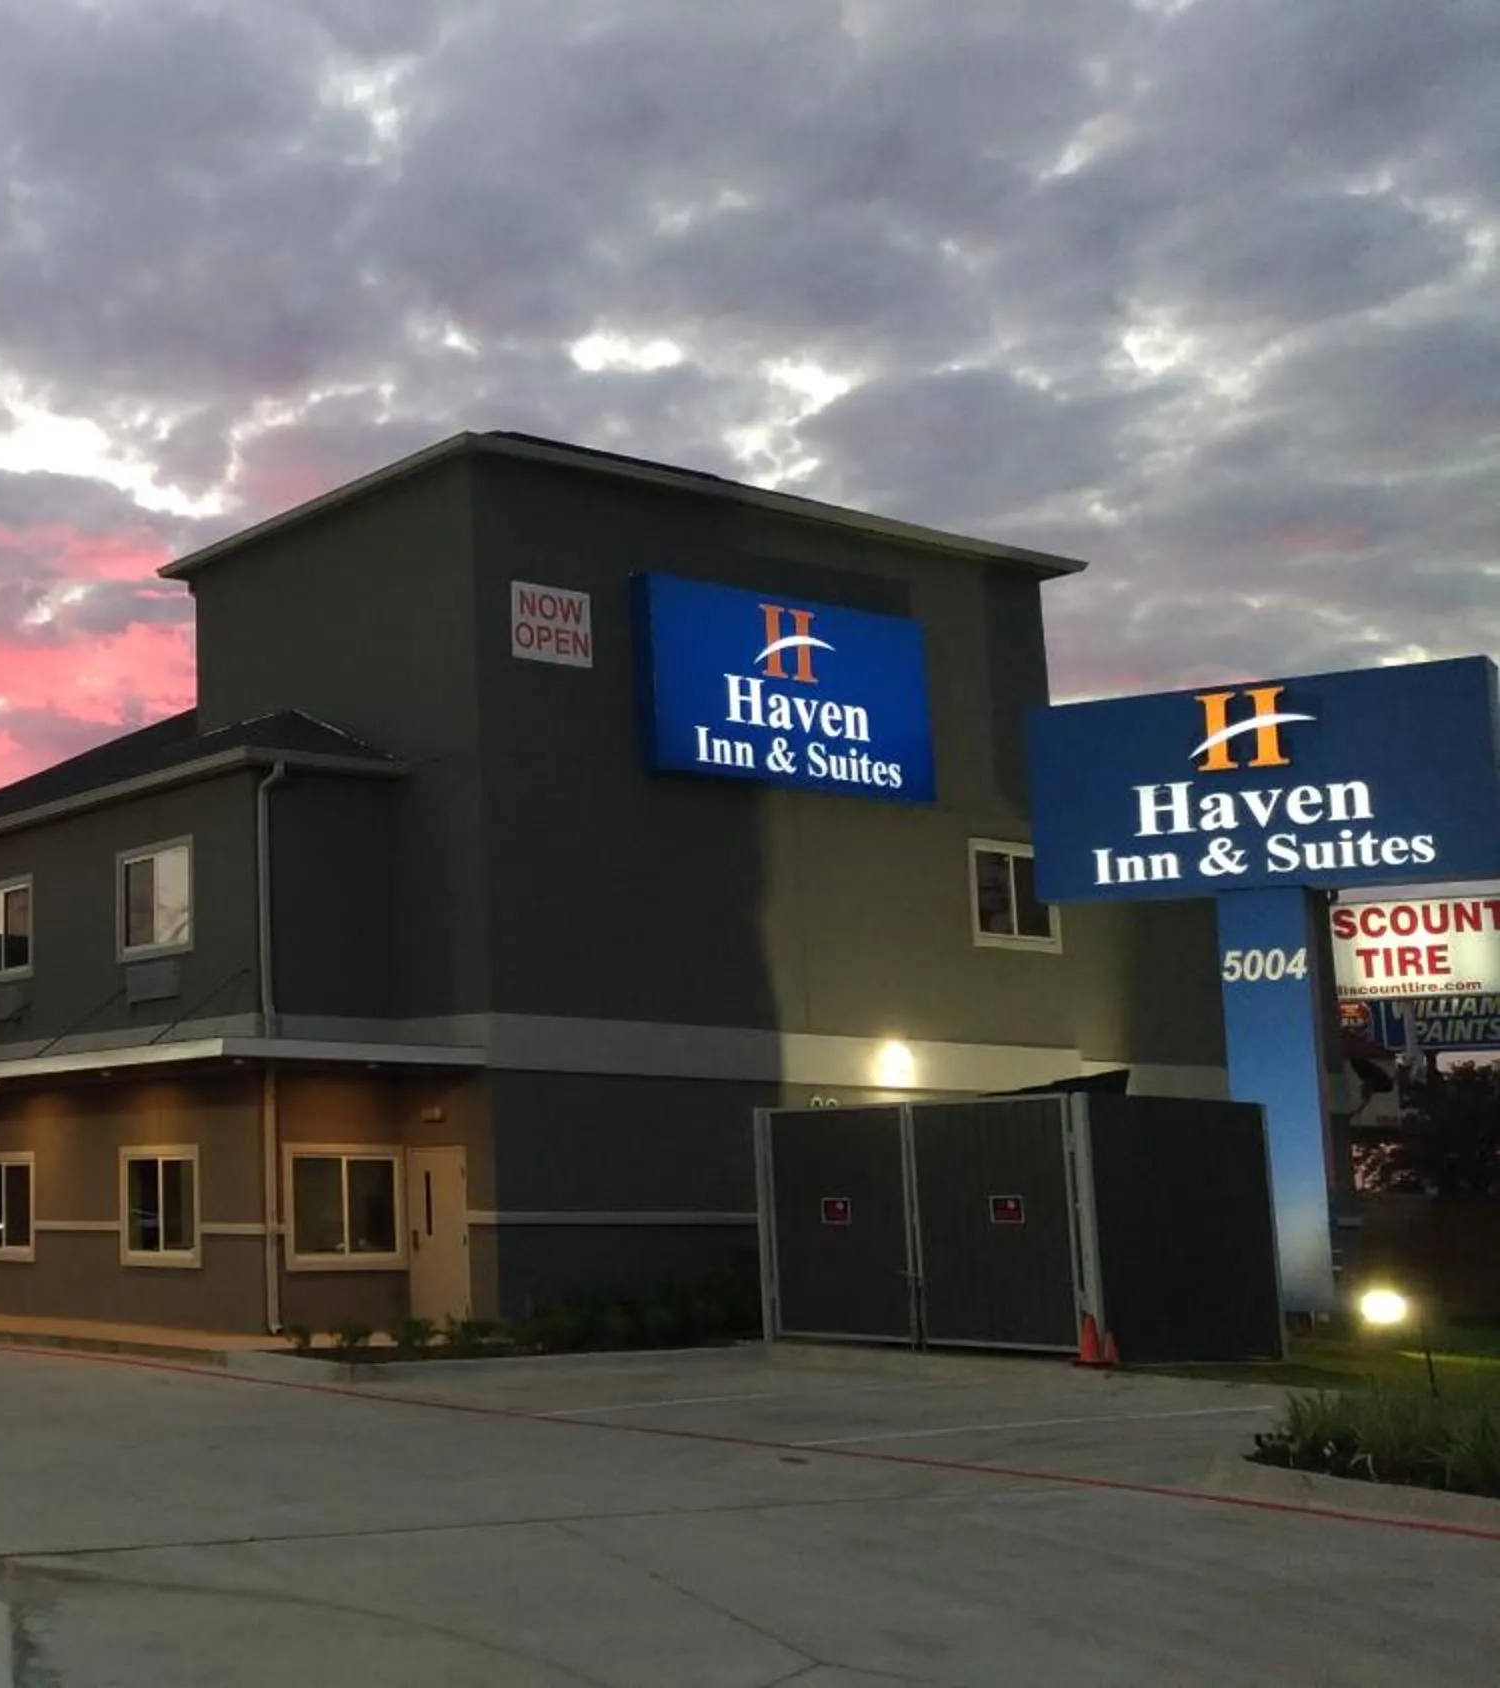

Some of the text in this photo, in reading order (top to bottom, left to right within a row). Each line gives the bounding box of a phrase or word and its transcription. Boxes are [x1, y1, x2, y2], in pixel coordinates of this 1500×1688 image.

[519, 590, 583, 625] NOW
[515, 622, 589, 659] OPEN
[724, 673, 871, 743] Haven
[694, 725, 903, 789] Inn & Suites
[1131, 780, 1374, 837] Haven
[1092, 829, 1436, 886] Inn & Suites
[1332, 899, 1500, 940] SCOUNT
[1222, 948, 1308, 982] 5004
[1355, 944, 1452, 979] TIRE
